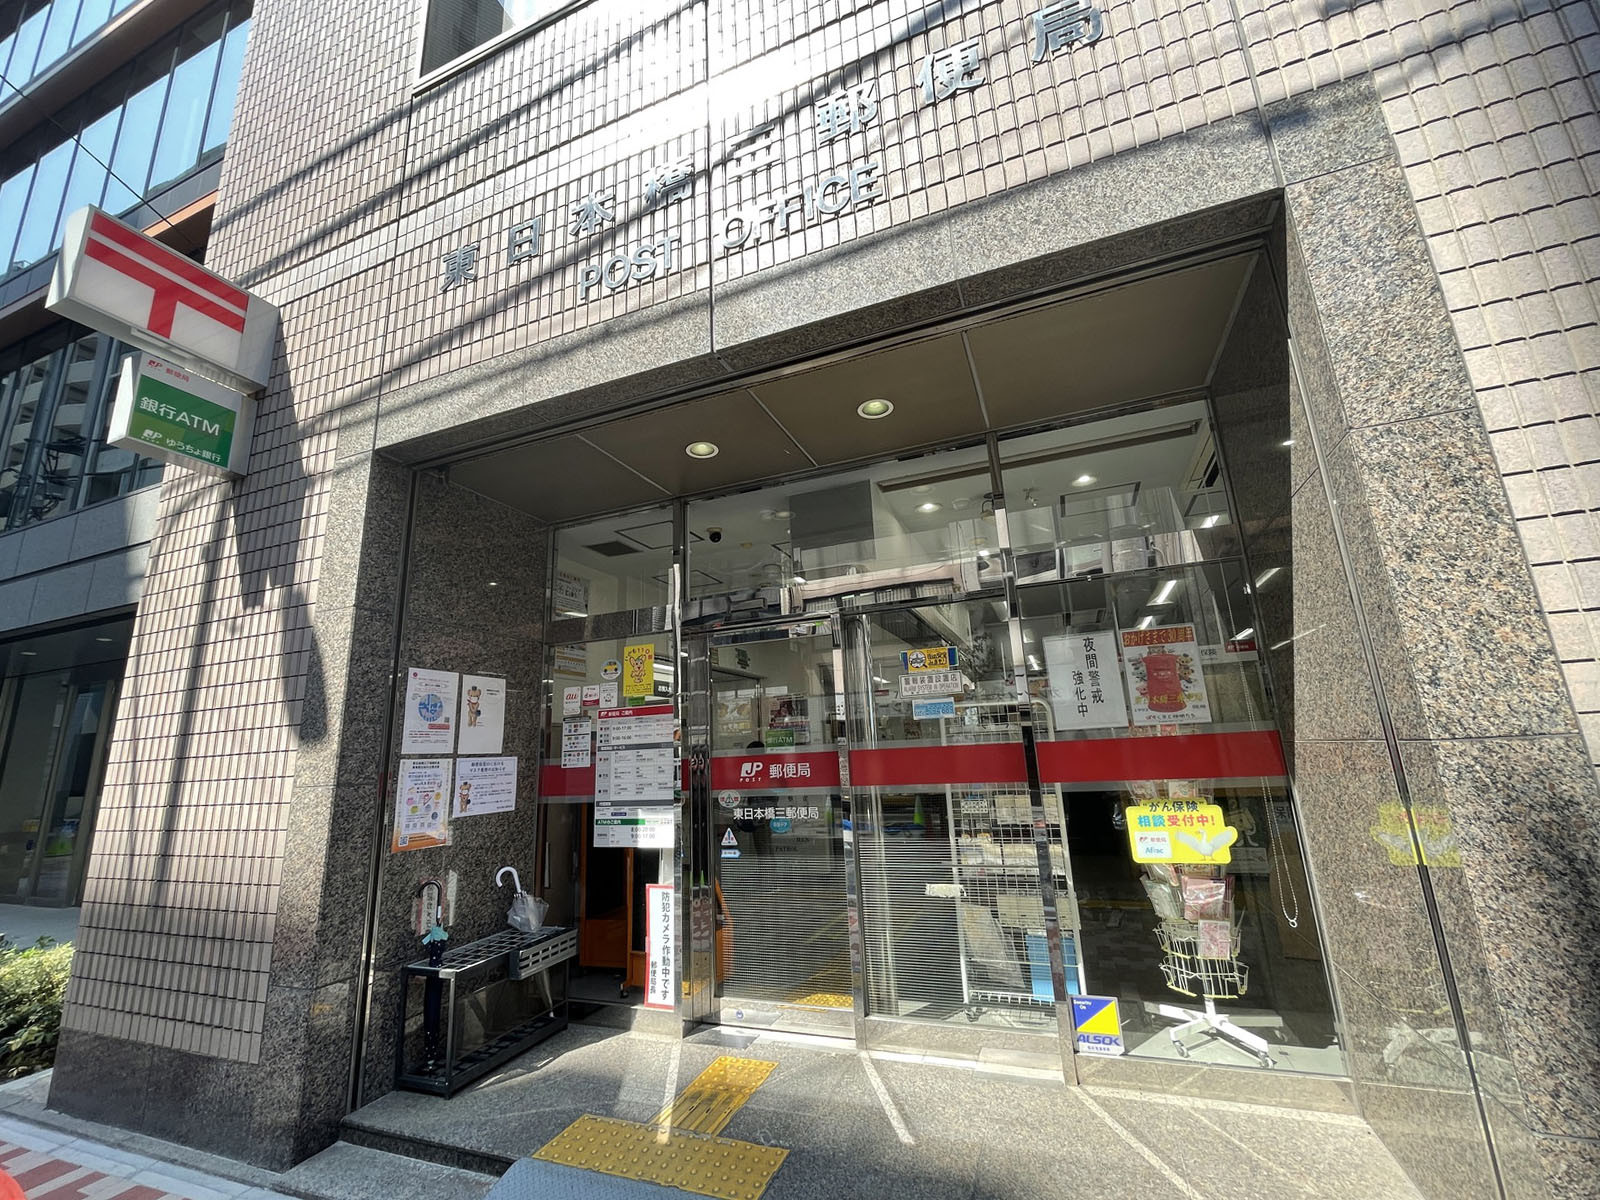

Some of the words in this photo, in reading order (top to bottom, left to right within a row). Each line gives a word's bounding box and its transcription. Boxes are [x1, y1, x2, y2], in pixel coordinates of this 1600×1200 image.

[439, 0, 1103, 293] 東日本橋三郵便局
[579, 232, 680, 301] POST
[721, 160, 884, 250] OFFICE
[139, 396, 221, 437] 銀行ATM
[165, 437, 222, 463] ゆうちょ銀行
[1082, 636, 1105, 705] 夜間警戒
[1071, 670, 1090, 719] 強化中
[769, 762, 811, 779] 郵便局
[732, 806, 819, 821] 東日本橋三郵便局
[1145, 845, 1164, 855] Aflac
[660, 891, 671, 1001] 防犯カメラ作動中です
[1077, 1034, 1121, 1047] ALSOK
